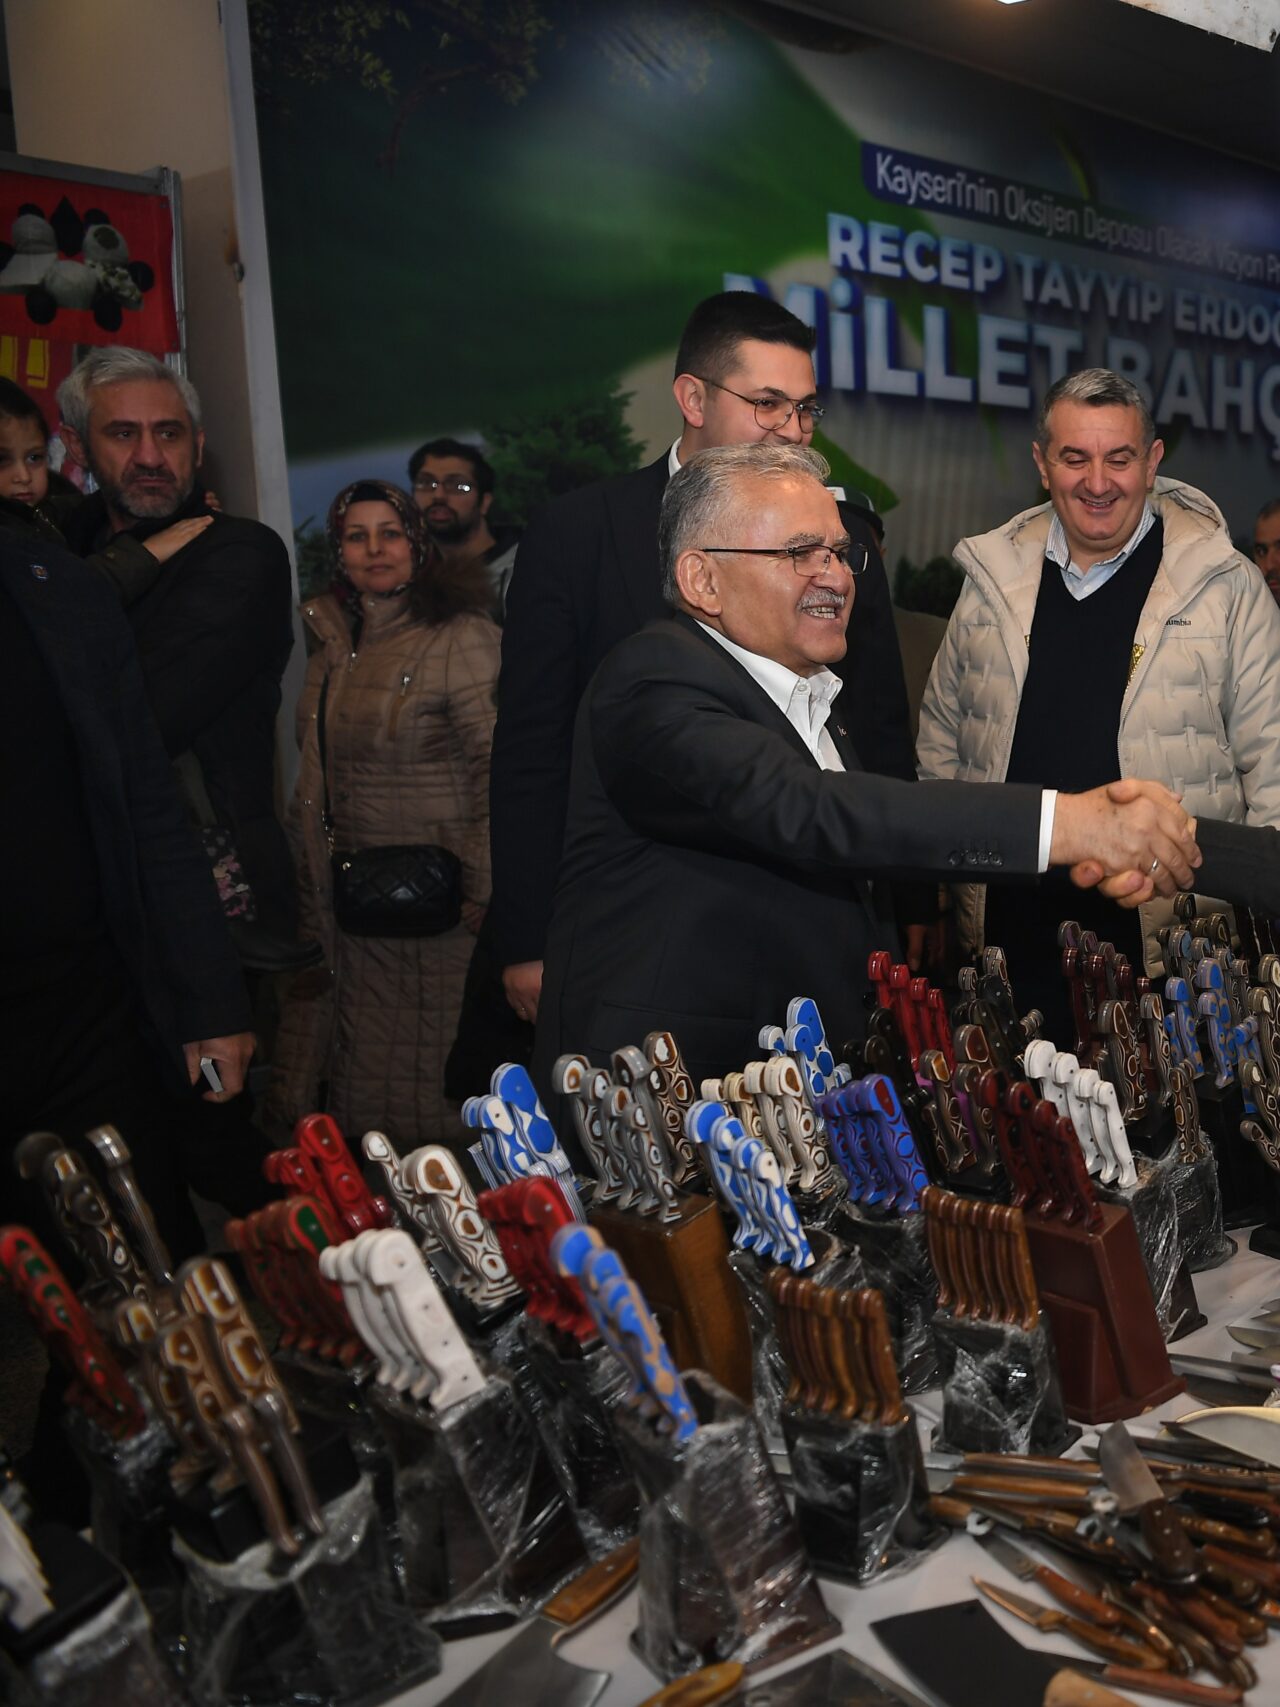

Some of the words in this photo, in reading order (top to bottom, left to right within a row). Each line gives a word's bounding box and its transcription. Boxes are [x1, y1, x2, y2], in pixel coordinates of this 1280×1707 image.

[827, 212, 1004, 293] RECEP
[1005, 186, 1079, 238] Oksijen
[1083, 208, 1153, 255] Deposu
[1156, 227, 1213, 268] Olacak
[1215, 241, 1264, 282] Vizyon
